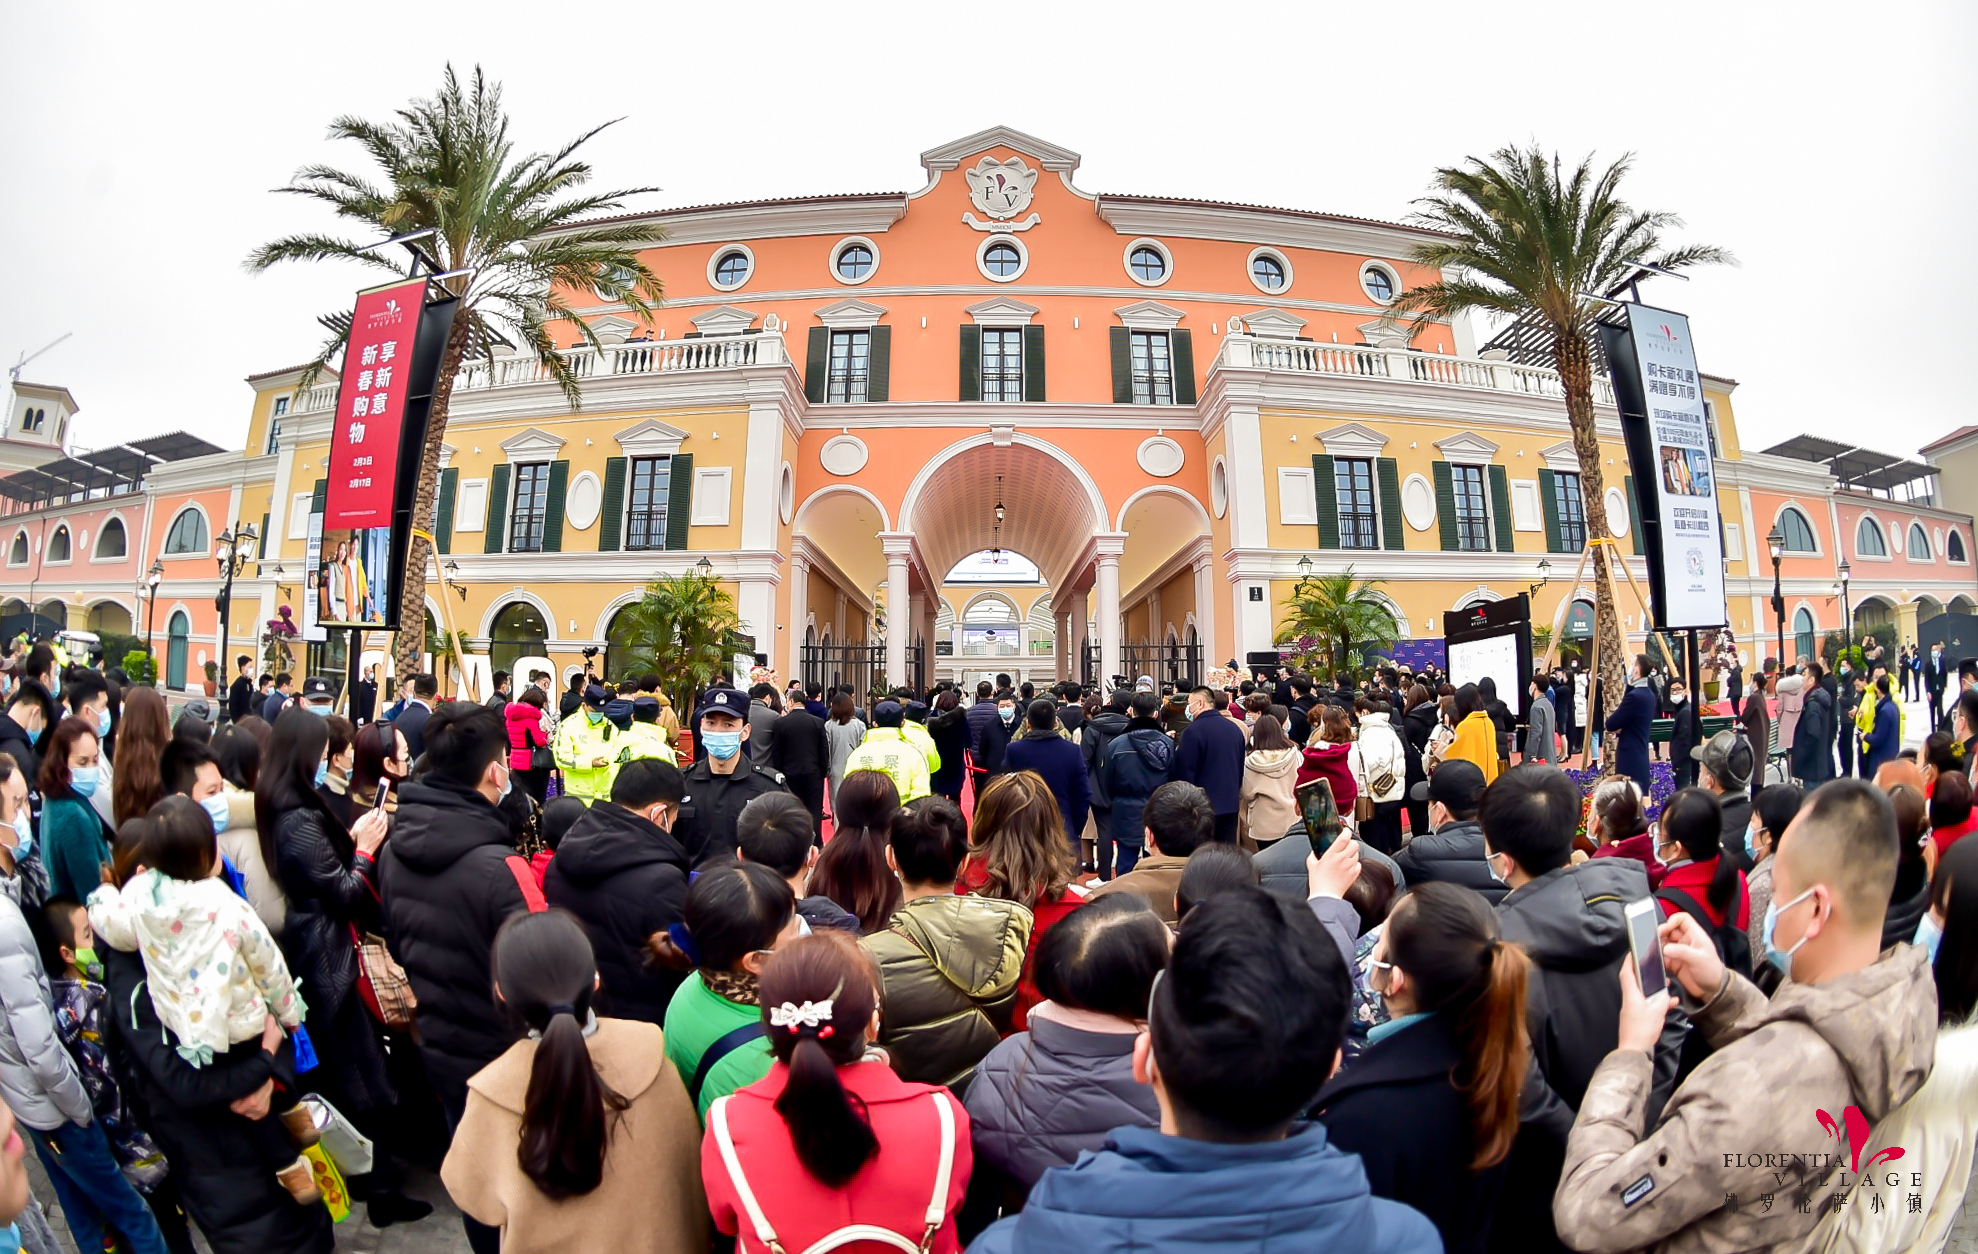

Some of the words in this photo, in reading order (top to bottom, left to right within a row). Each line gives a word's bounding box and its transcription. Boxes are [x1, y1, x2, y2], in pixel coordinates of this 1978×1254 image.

[984, 186, 995, 200] F
[1003, 194, 1018, 207] V
[371, 341, 397, 414] 享新意
[1647, 362, 1694, 384] 购卡新礼遇
[349, 344, 378, 444] 新春购物
[353, 455, 373, 467] 2月3日
[349, 477, 372, 488] 2月17日
[859, 754, 899, 771] 警察
